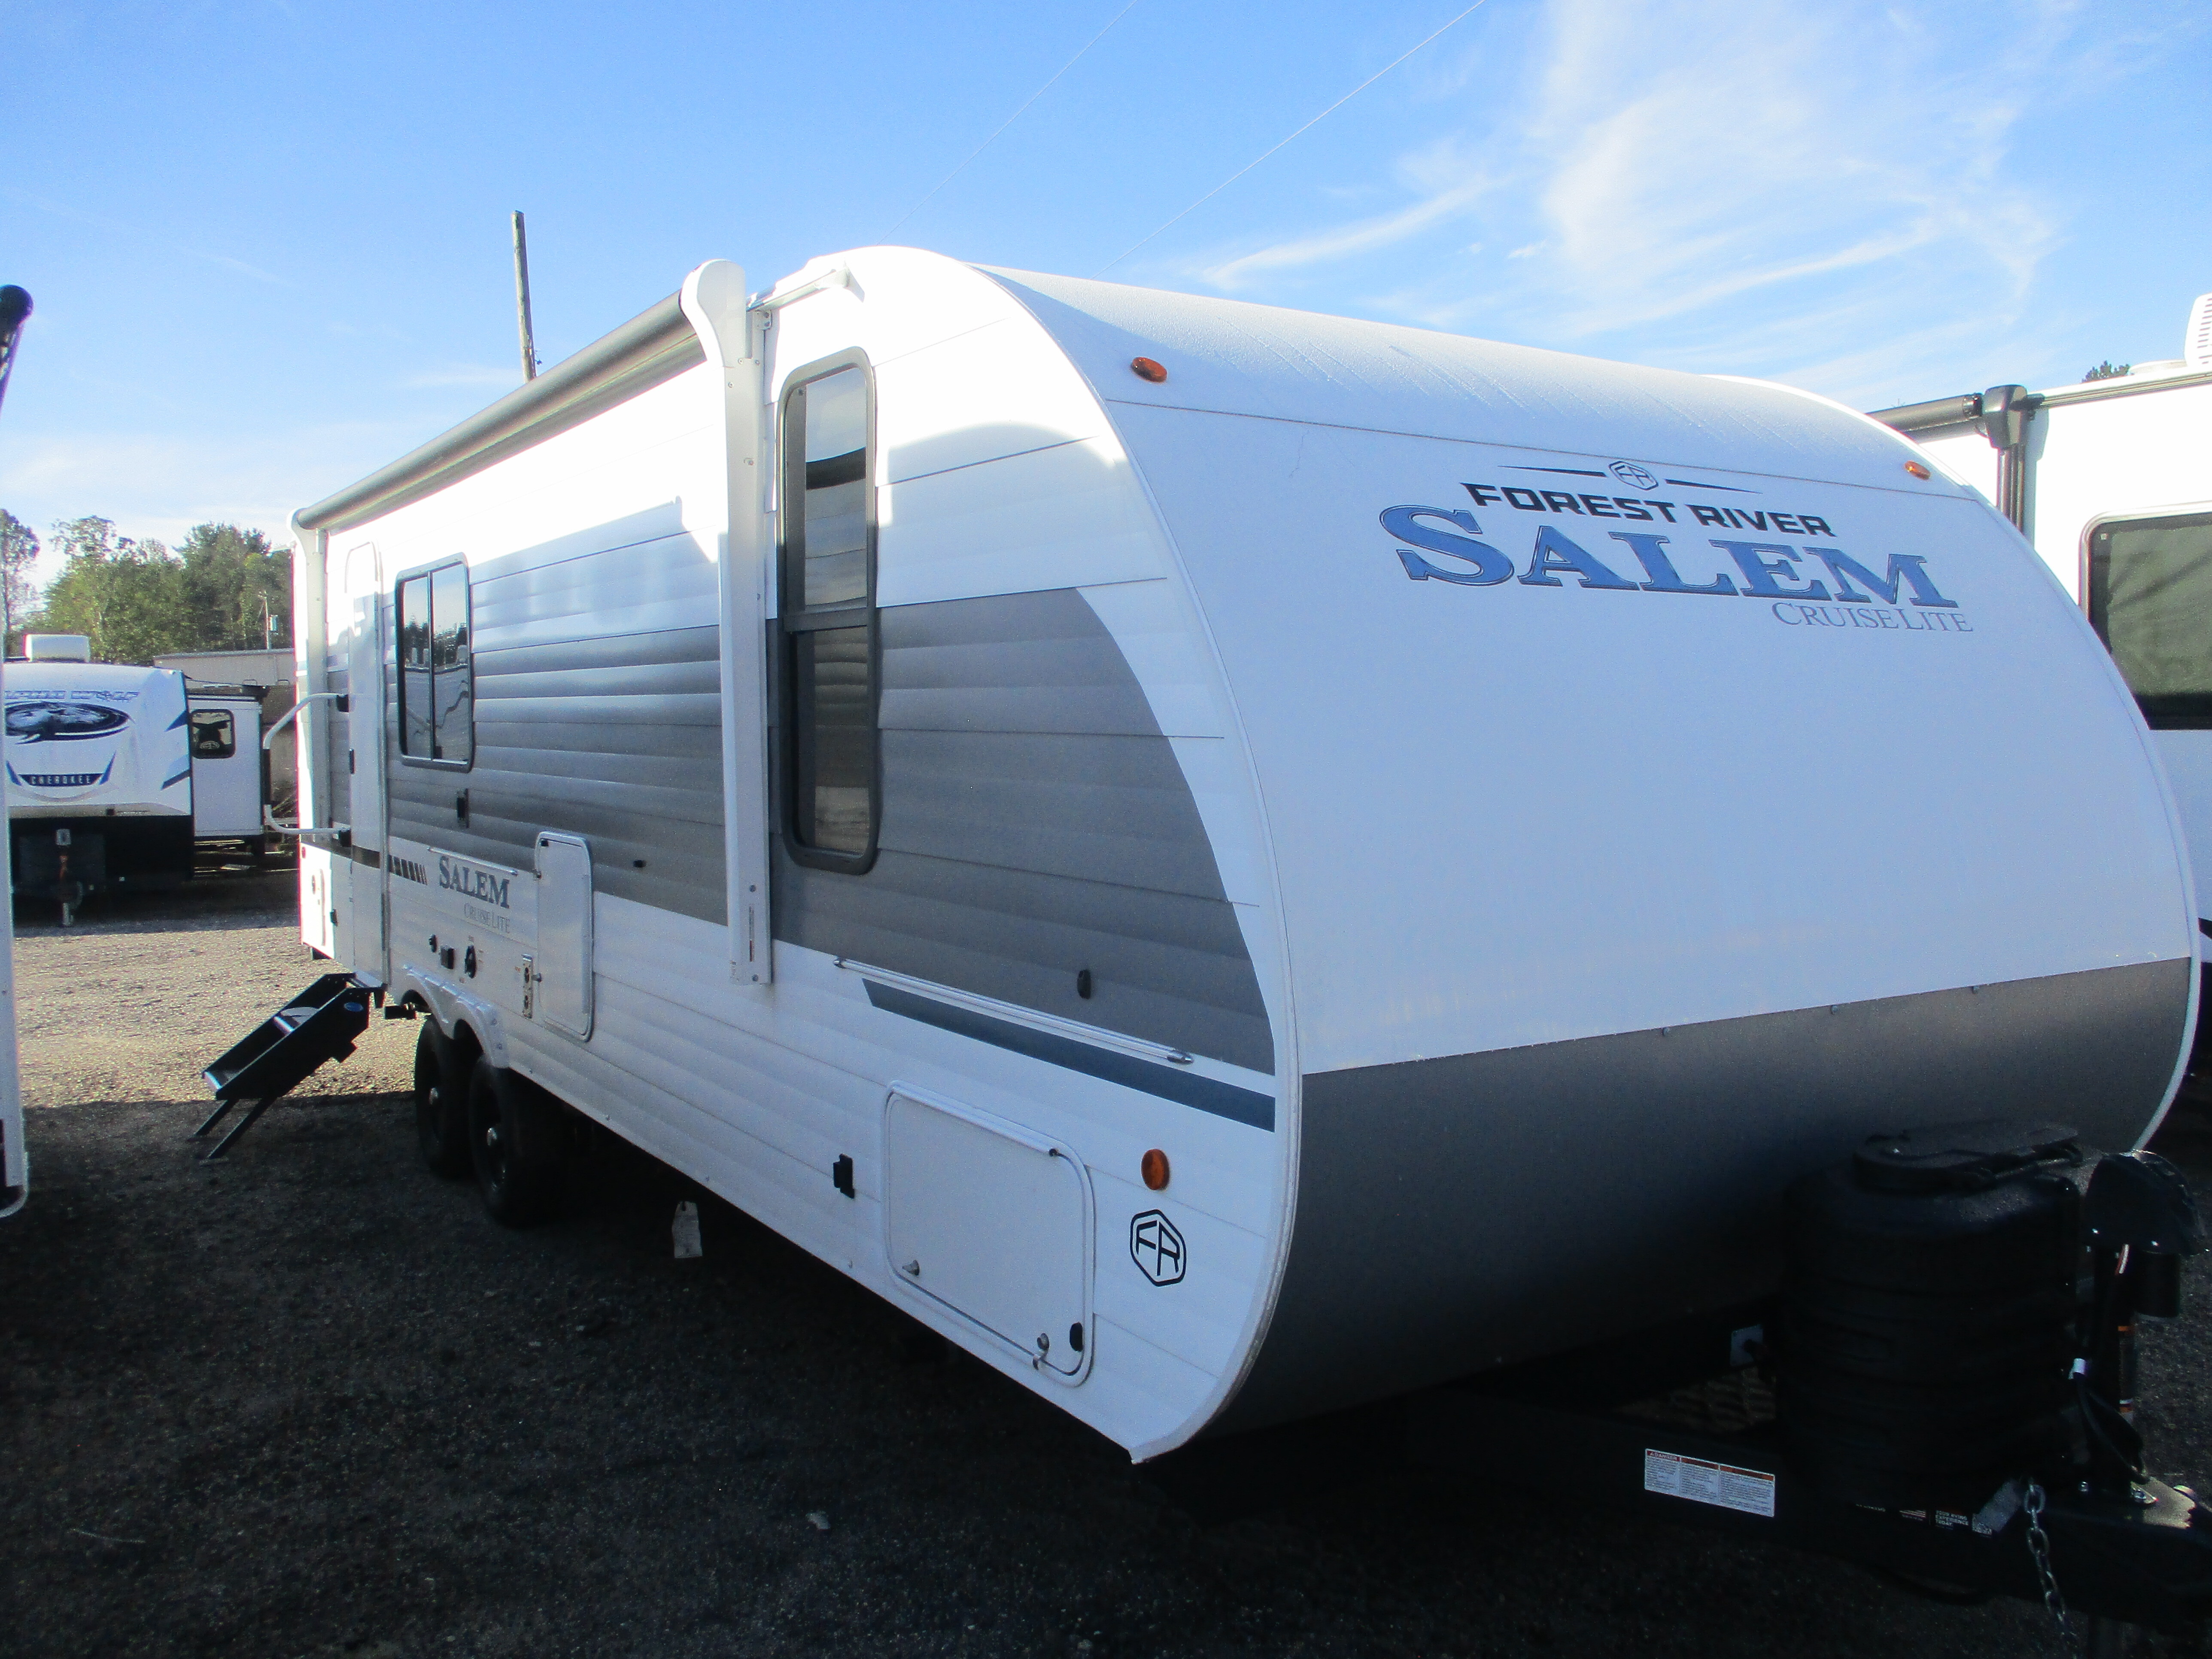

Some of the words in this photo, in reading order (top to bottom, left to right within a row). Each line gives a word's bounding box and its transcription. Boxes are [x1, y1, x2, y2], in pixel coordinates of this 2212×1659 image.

[1460, 482, 1677, 523] FOREST
[1684, 504, 1837, 537] RIVER
[1378, 504, 1959, 609] SALEM
[439, 856, 510, 909] SALEM
